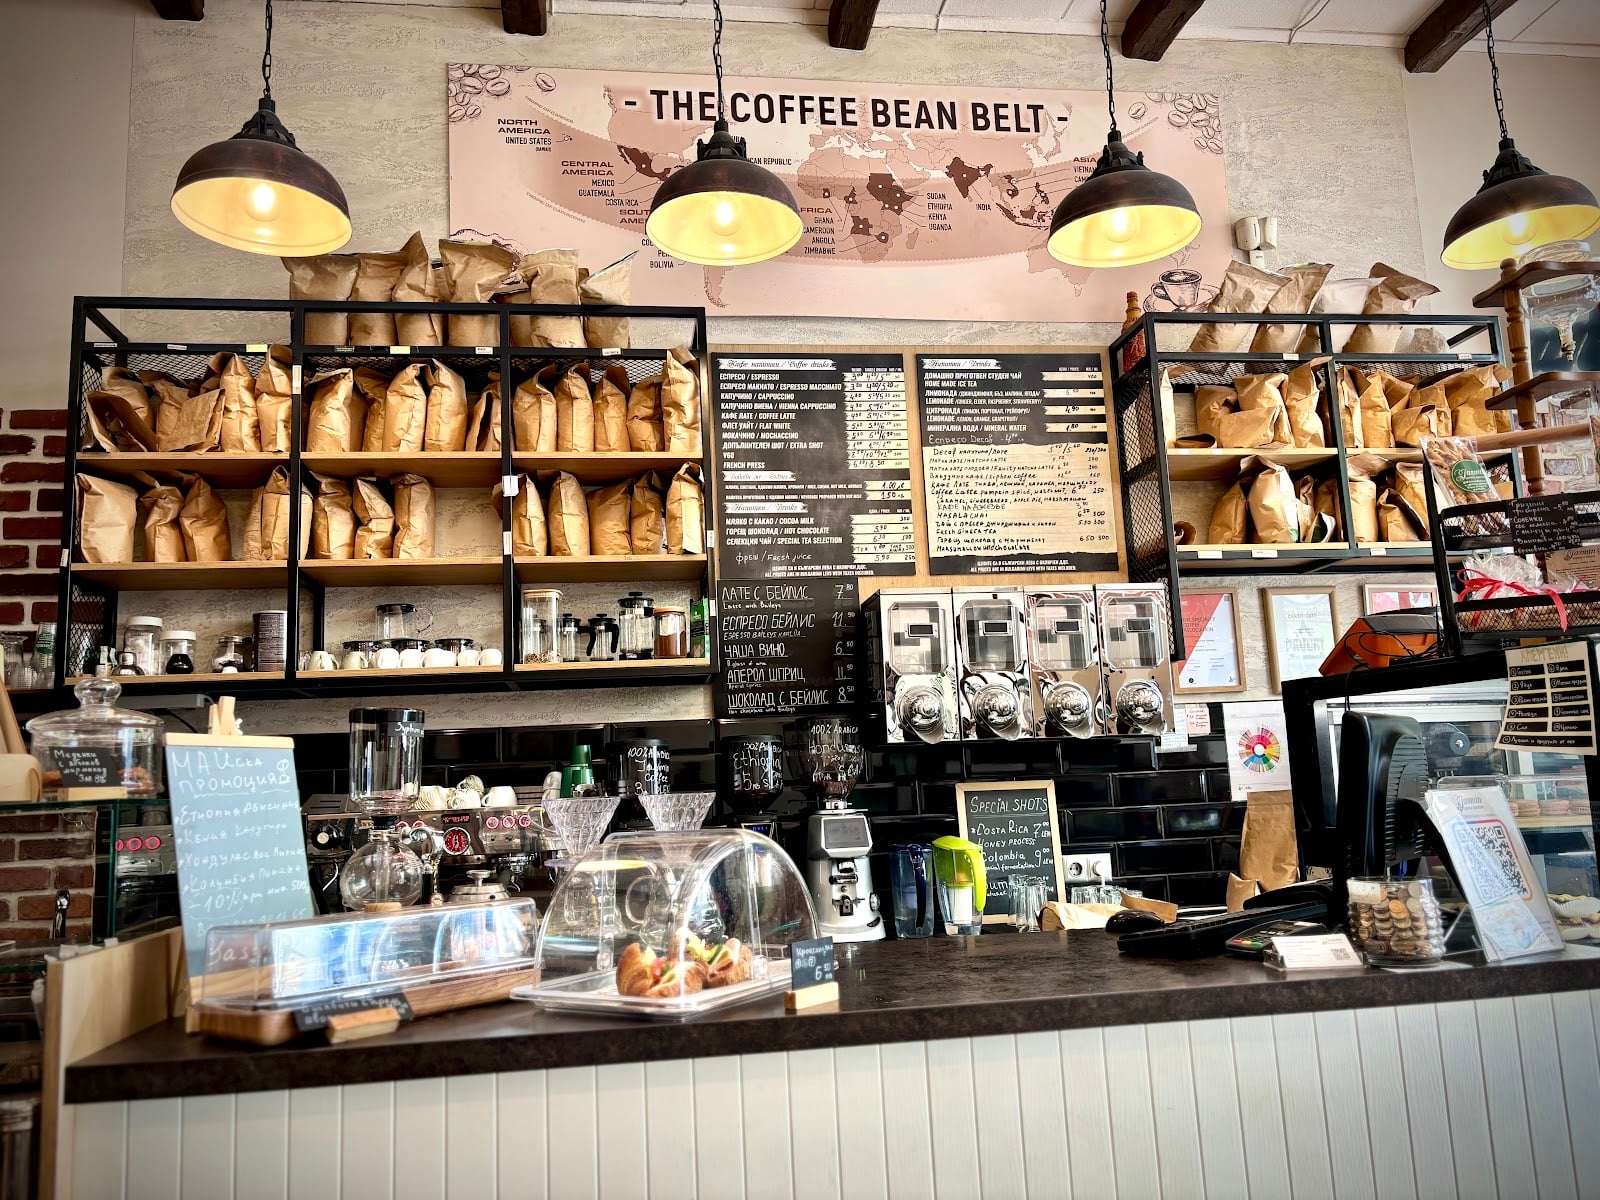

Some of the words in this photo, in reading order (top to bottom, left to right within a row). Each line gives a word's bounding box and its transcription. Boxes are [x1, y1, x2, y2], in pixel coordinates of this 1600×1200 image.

[650, 90, 717, 121] THE
[730, 93, 857, 126] COFFEE
[871, 99, 957, 130] BEAN
[971, 103, 1044, 133] BELT
[497, 118, 538, 126] NORTH
[498, 127, 551, 135] AMERICA
[505, 136, 527, 145] UNITED
[528, 137, 552, 146] STATES
[561, 160, 614, 168] CENTRAL
[763, 157, 792, 166] REPUBLIC
[591, 179, 615, 187] MEXICO
[578, 189, 615, 198] GUATEMALA
[926, 192, 946, 200] SUDAN
[605, 198, 624, 206] COSTA
[927, 202, 953, 211] ETHIOPIA
[975, 203, 992, 211] INDIA
[814, 216, 834, 225] GHANA
[928, 213, 947, 221] KENYA
[928, 223, 953, 231] UGANDA
[812, 236, 836, 245] ANGOLA
[804, 246, 836, 255] ZIMBABWE
[649, 260, 674, 269] BOLIVIA
[719, 373, 746, 381] ЕСПРЕСО
[751, 373, 780, 381] ESPRESSO
[923, 372, 954, 380] ДОМАШНО
[955, 372, 987, 380] ПРИГОТВЕН
[987, 372, 1010, 381] СТУДЕН
[1010, 371, 1022, 380] ЧАЙ
[719, 383, 746, 391] ЕСПРЕСО
[780, 383, 808, 391] ESPRESSO
[809, 383, 842, 391] MACCHIATO
[924, 380, 941, 388] HOME
[941, 380, 957, 388] MADE
[957, 380, 967, 388] ICE
[967, 380, 978, 388] TEA
[925, 389, 957, 397] ЛИМОНАДА
[925, 397, 954, 405] LEMONADE
[800, 402, 837, 410] CAPPUCCINO
[926, 407, 960, 415] ЦИТРОНАДА
[721, 412, 738, 420] КАФЕ
[758, 412, 780, 420] COFFEE
[780, 412, 797, 420] LATTE
[721, 422, 739, 430] ФЛЕТ
[759, 422, 773, 430] FLAT
[773, 422, 792, 430] WHITE
[927, 424, 961, 432] МИНЕРАЛНА
[962, 424, 979, 433] ВОДА
[983, 424, 1007, 432] MINERAL
[1008, 424, 1027, 432] WATER
[721, 432, 755, 440] МОКАЧИНО
[760, 432, 799, 440] MOCHACCINO
[808, 441, 824, 449] SHOT
[722, 451, 735, 459] V60
[723, 461, 746, 469] FRENCH
[746, 461, 765, 469] PRESS
[754, 517, 774, 525] КАКАО
[779, 517, 799, 525] COCOA
[800, 517, 815, 525] MILK
[747, 528, 779, 536] ШОКОЛАД
[784, 527, 796, 535] HOT
[797, 526, 830, 535] CHOCOLATE
[759, 536, 772, 545] ЧАЙ
[777, 537, 800, 545] SPECIAL
[801, 537, 812, 545] TEA
[813, 536, 843, 545] SELECTION
[722, 586, 751, 600] ЛАТЕ
[753, 585, 761, 600] С
[765, 583, 809, 600] БЕЙЛИС
[722, 614, 769, 631] ЕСПРЕСО
[770, 611, 817, 629] БЕЙЛИС
[724, 643, 755, 658] ЧАША
[758, 642, 786, 657] ВИНО
[727, 667, 765, 683] АПЕРОЛ
[768, 667, 806, 683] ШПРИЦ
[727, 692, 776, 708] ШОКОЛАД
[779, 691, 786, 706] С
[789, 688, 829, 705] БЕЙЛИС
[1012, 796, 1048, 812] SHOTS
[976, 822, 1007, 836] COSTA
